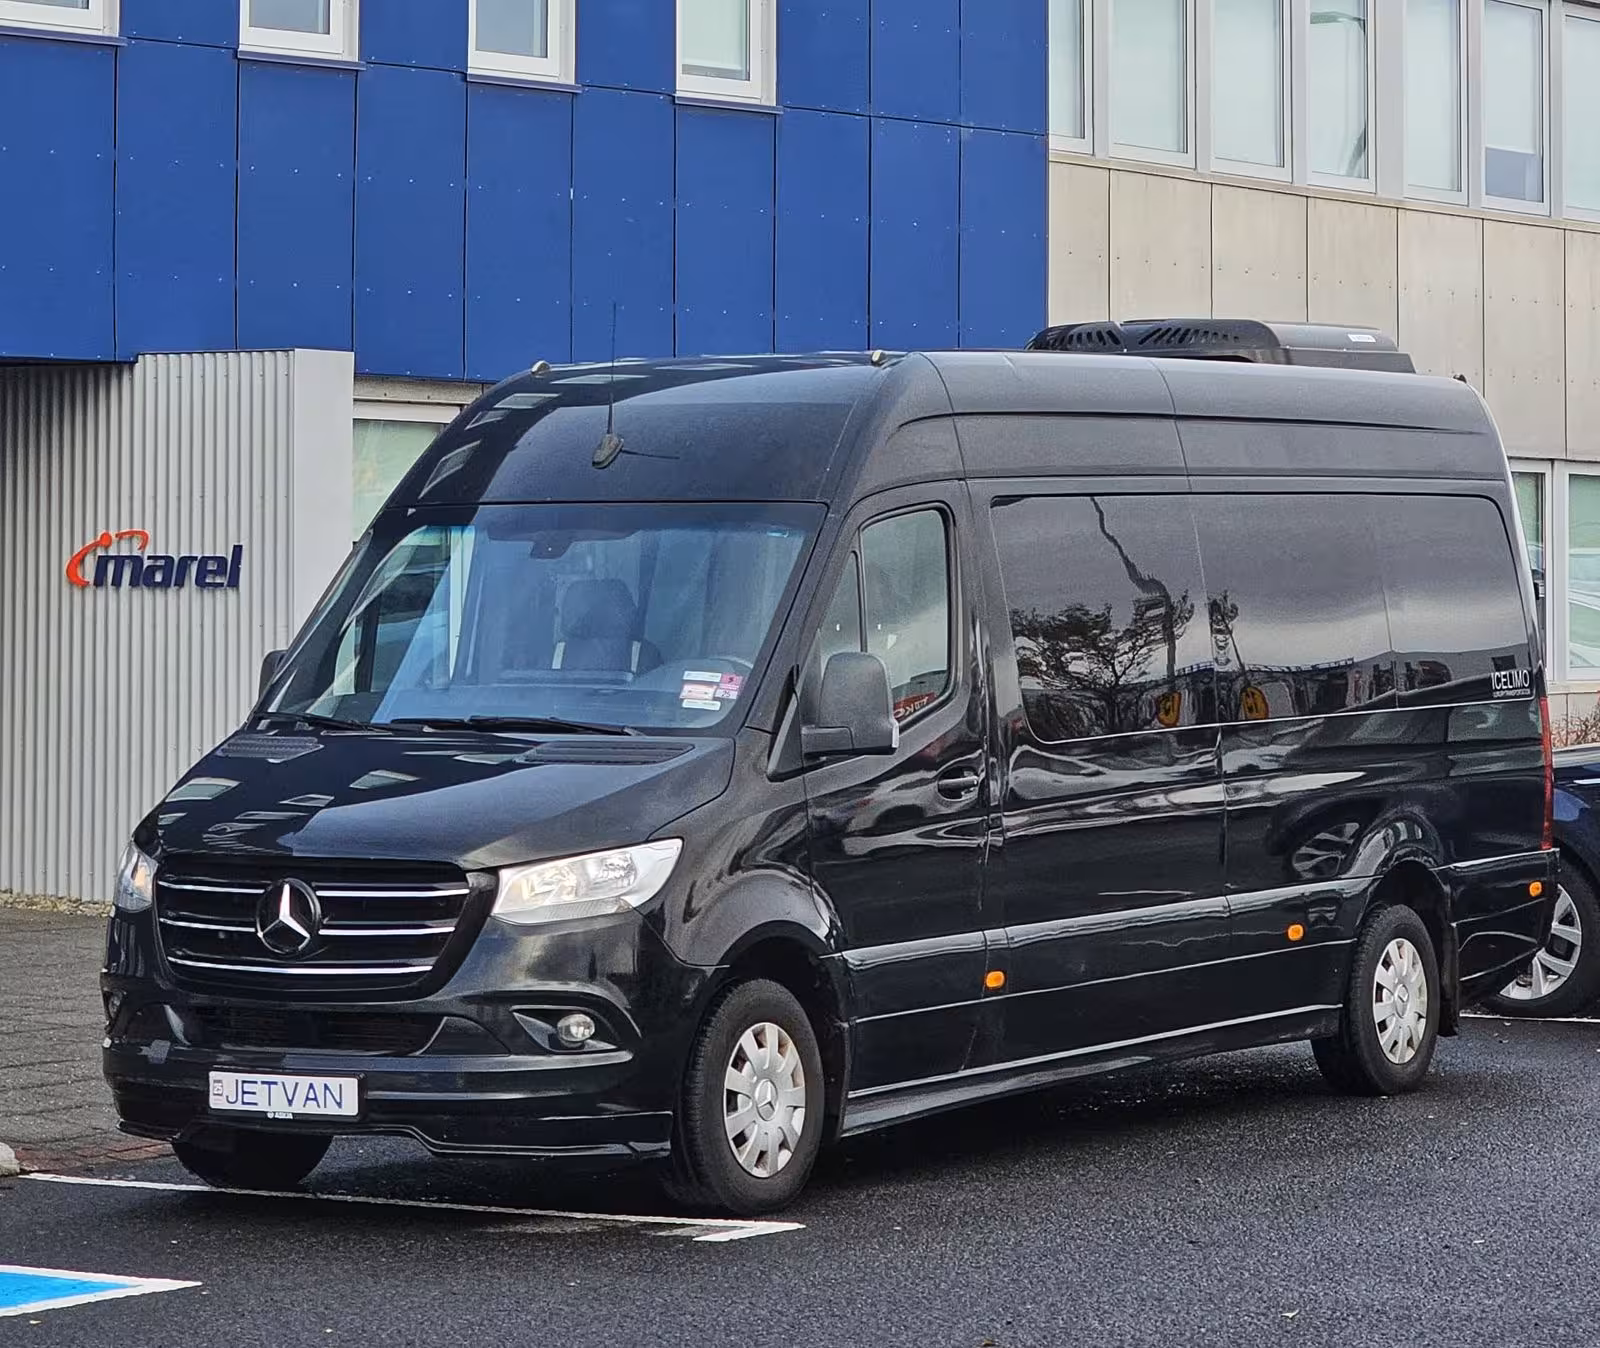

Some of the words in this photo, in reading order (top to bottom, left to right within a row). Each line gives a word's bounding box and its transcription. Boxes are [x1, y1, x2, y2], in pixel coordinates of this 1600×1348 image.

[93, 544, 243, 588] marel
[1491, 670, 1530, 690] ICELIMO
[225, 1079, 343, 1109] JETVAN
